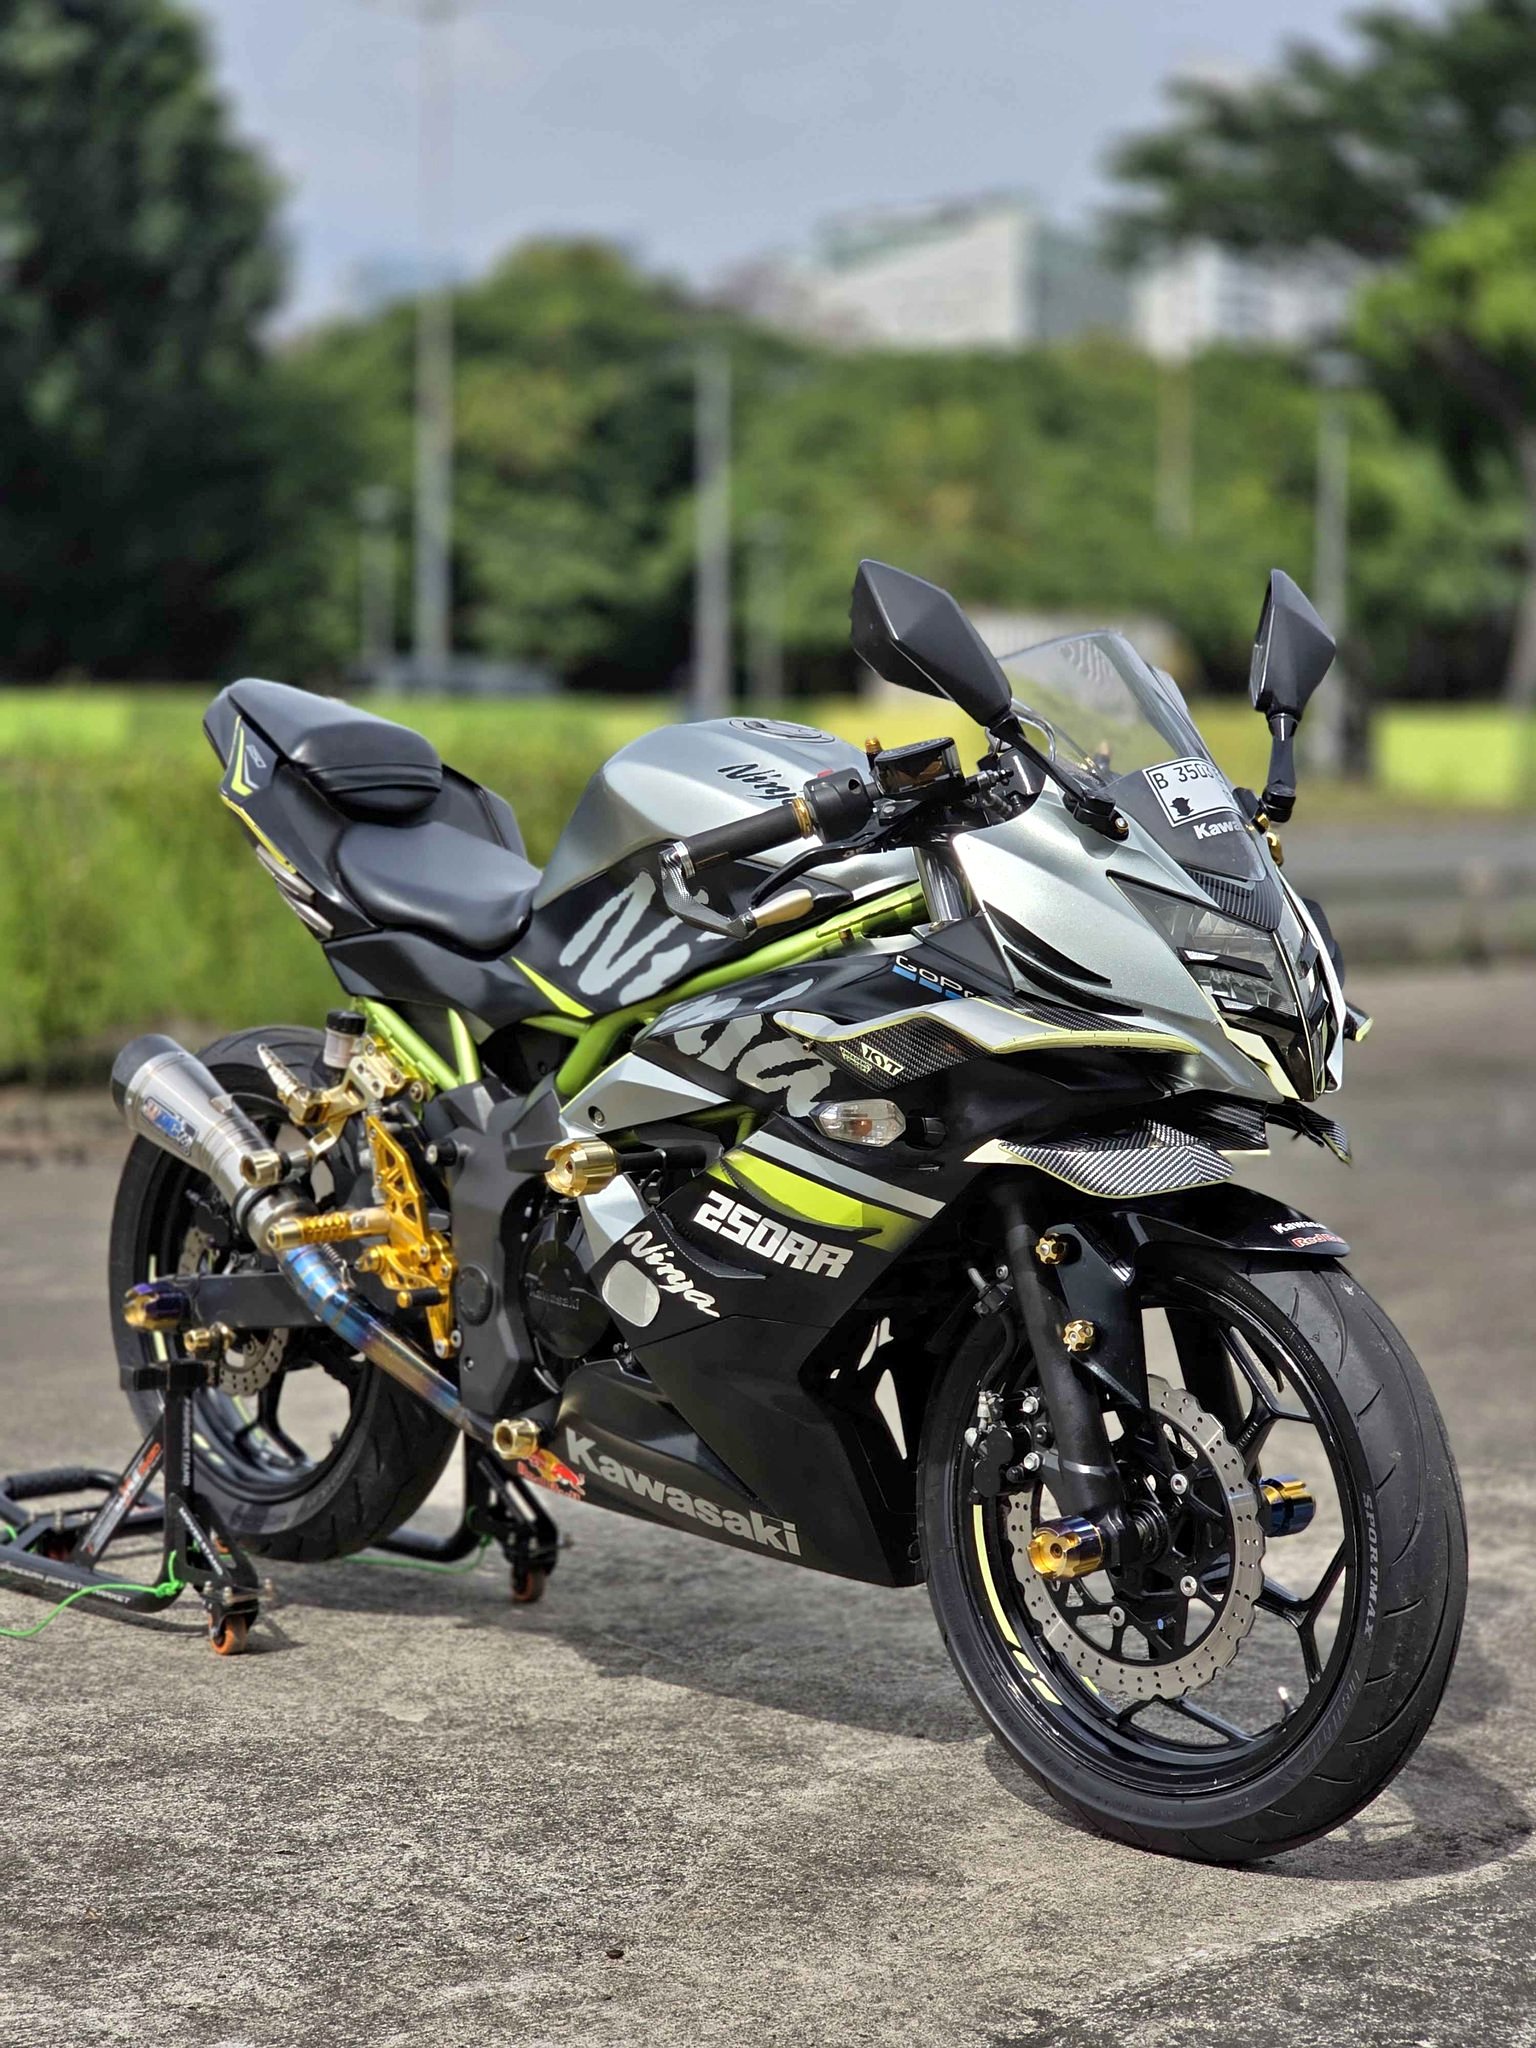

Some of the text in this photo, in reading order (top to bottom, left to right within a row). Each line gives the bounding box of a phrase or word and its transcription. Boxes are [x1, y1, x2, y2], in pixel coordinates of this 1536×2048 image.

[1153, 772, 1169, 790] B
[623, 1230, 721, 1318] Ninja
[693, 1190, 854, 1279] 250RR
[565, 1426, 802, 1557] Kawasaki
[1362, 1492, 1379, 1641] SPORTMAX
